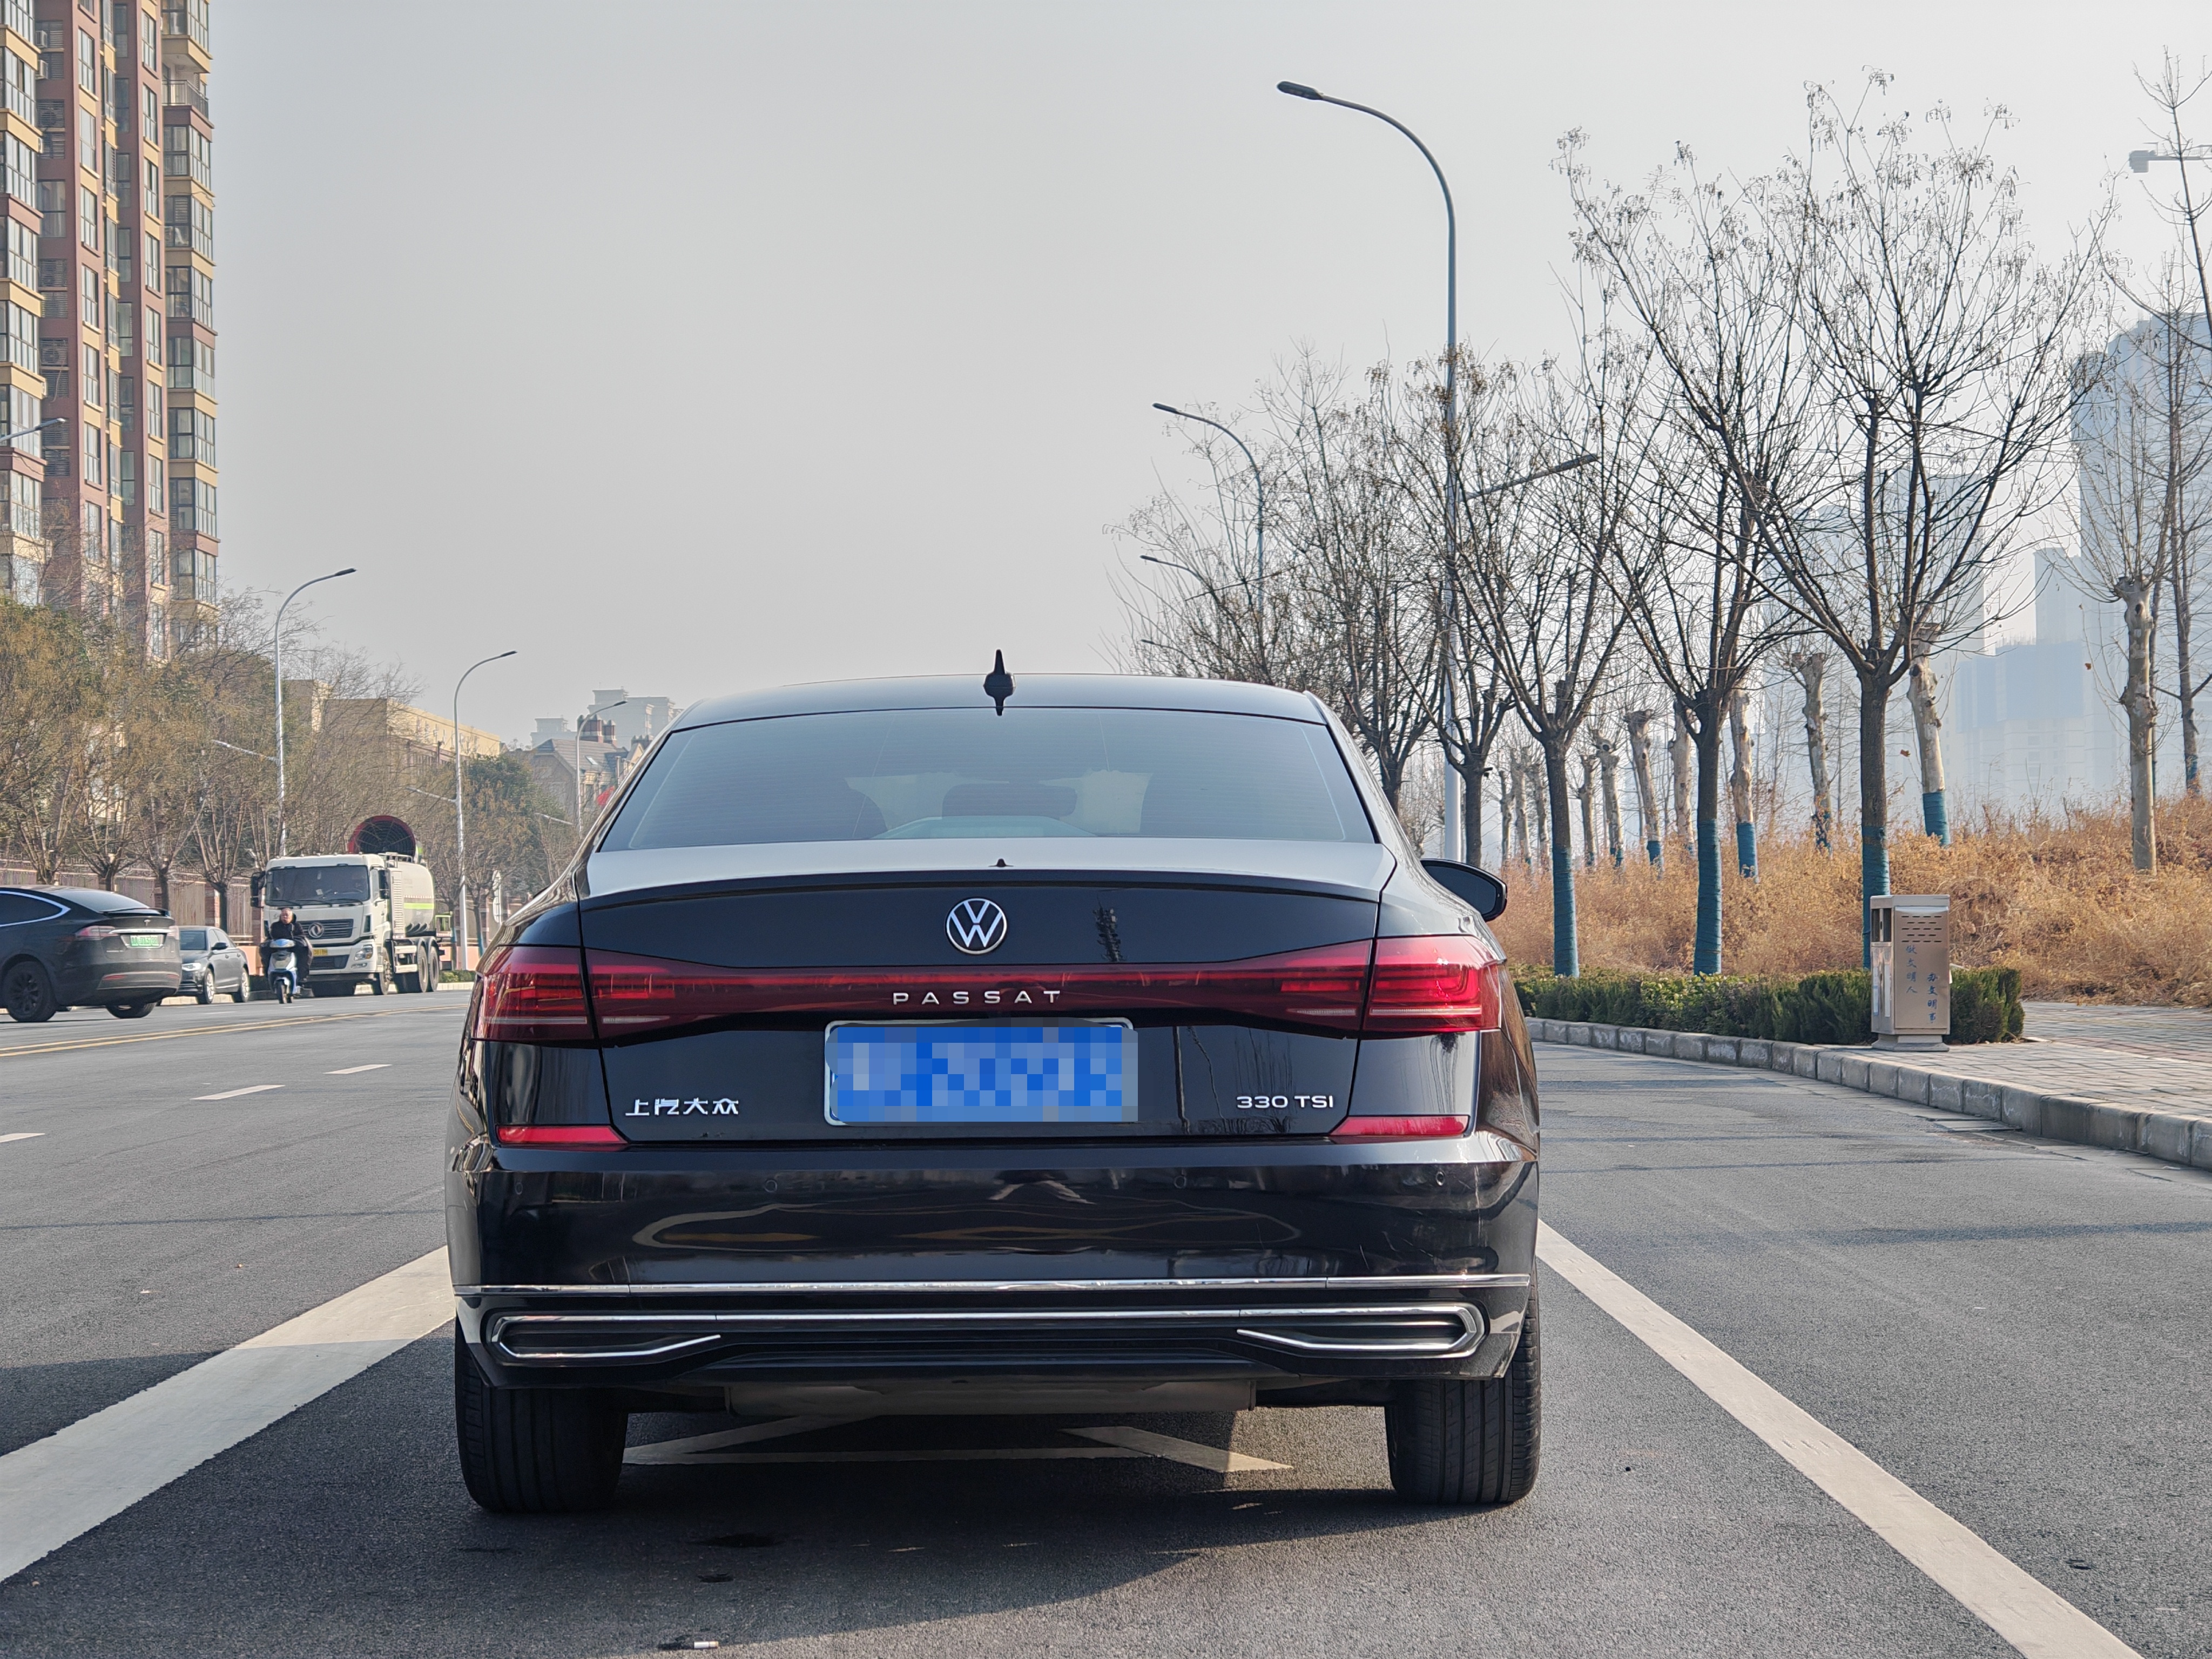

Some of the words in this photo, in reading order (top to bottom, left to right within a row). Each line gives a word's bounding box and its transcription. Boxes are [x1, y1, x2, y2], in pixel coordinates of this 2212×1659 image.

[947, 899, 1006, 952] VW
[1906, 945, 1917, 994] 做文明人
[893, 990, 1061, 1005] PASSAT
[1927, 972, 1938, 1023] 办文明事
[625, 1097, 738, 1116] 上汽大众
[1237, 1096, 1288, 1108] 330
[1294, 1095, 1333, 1108] TSI
